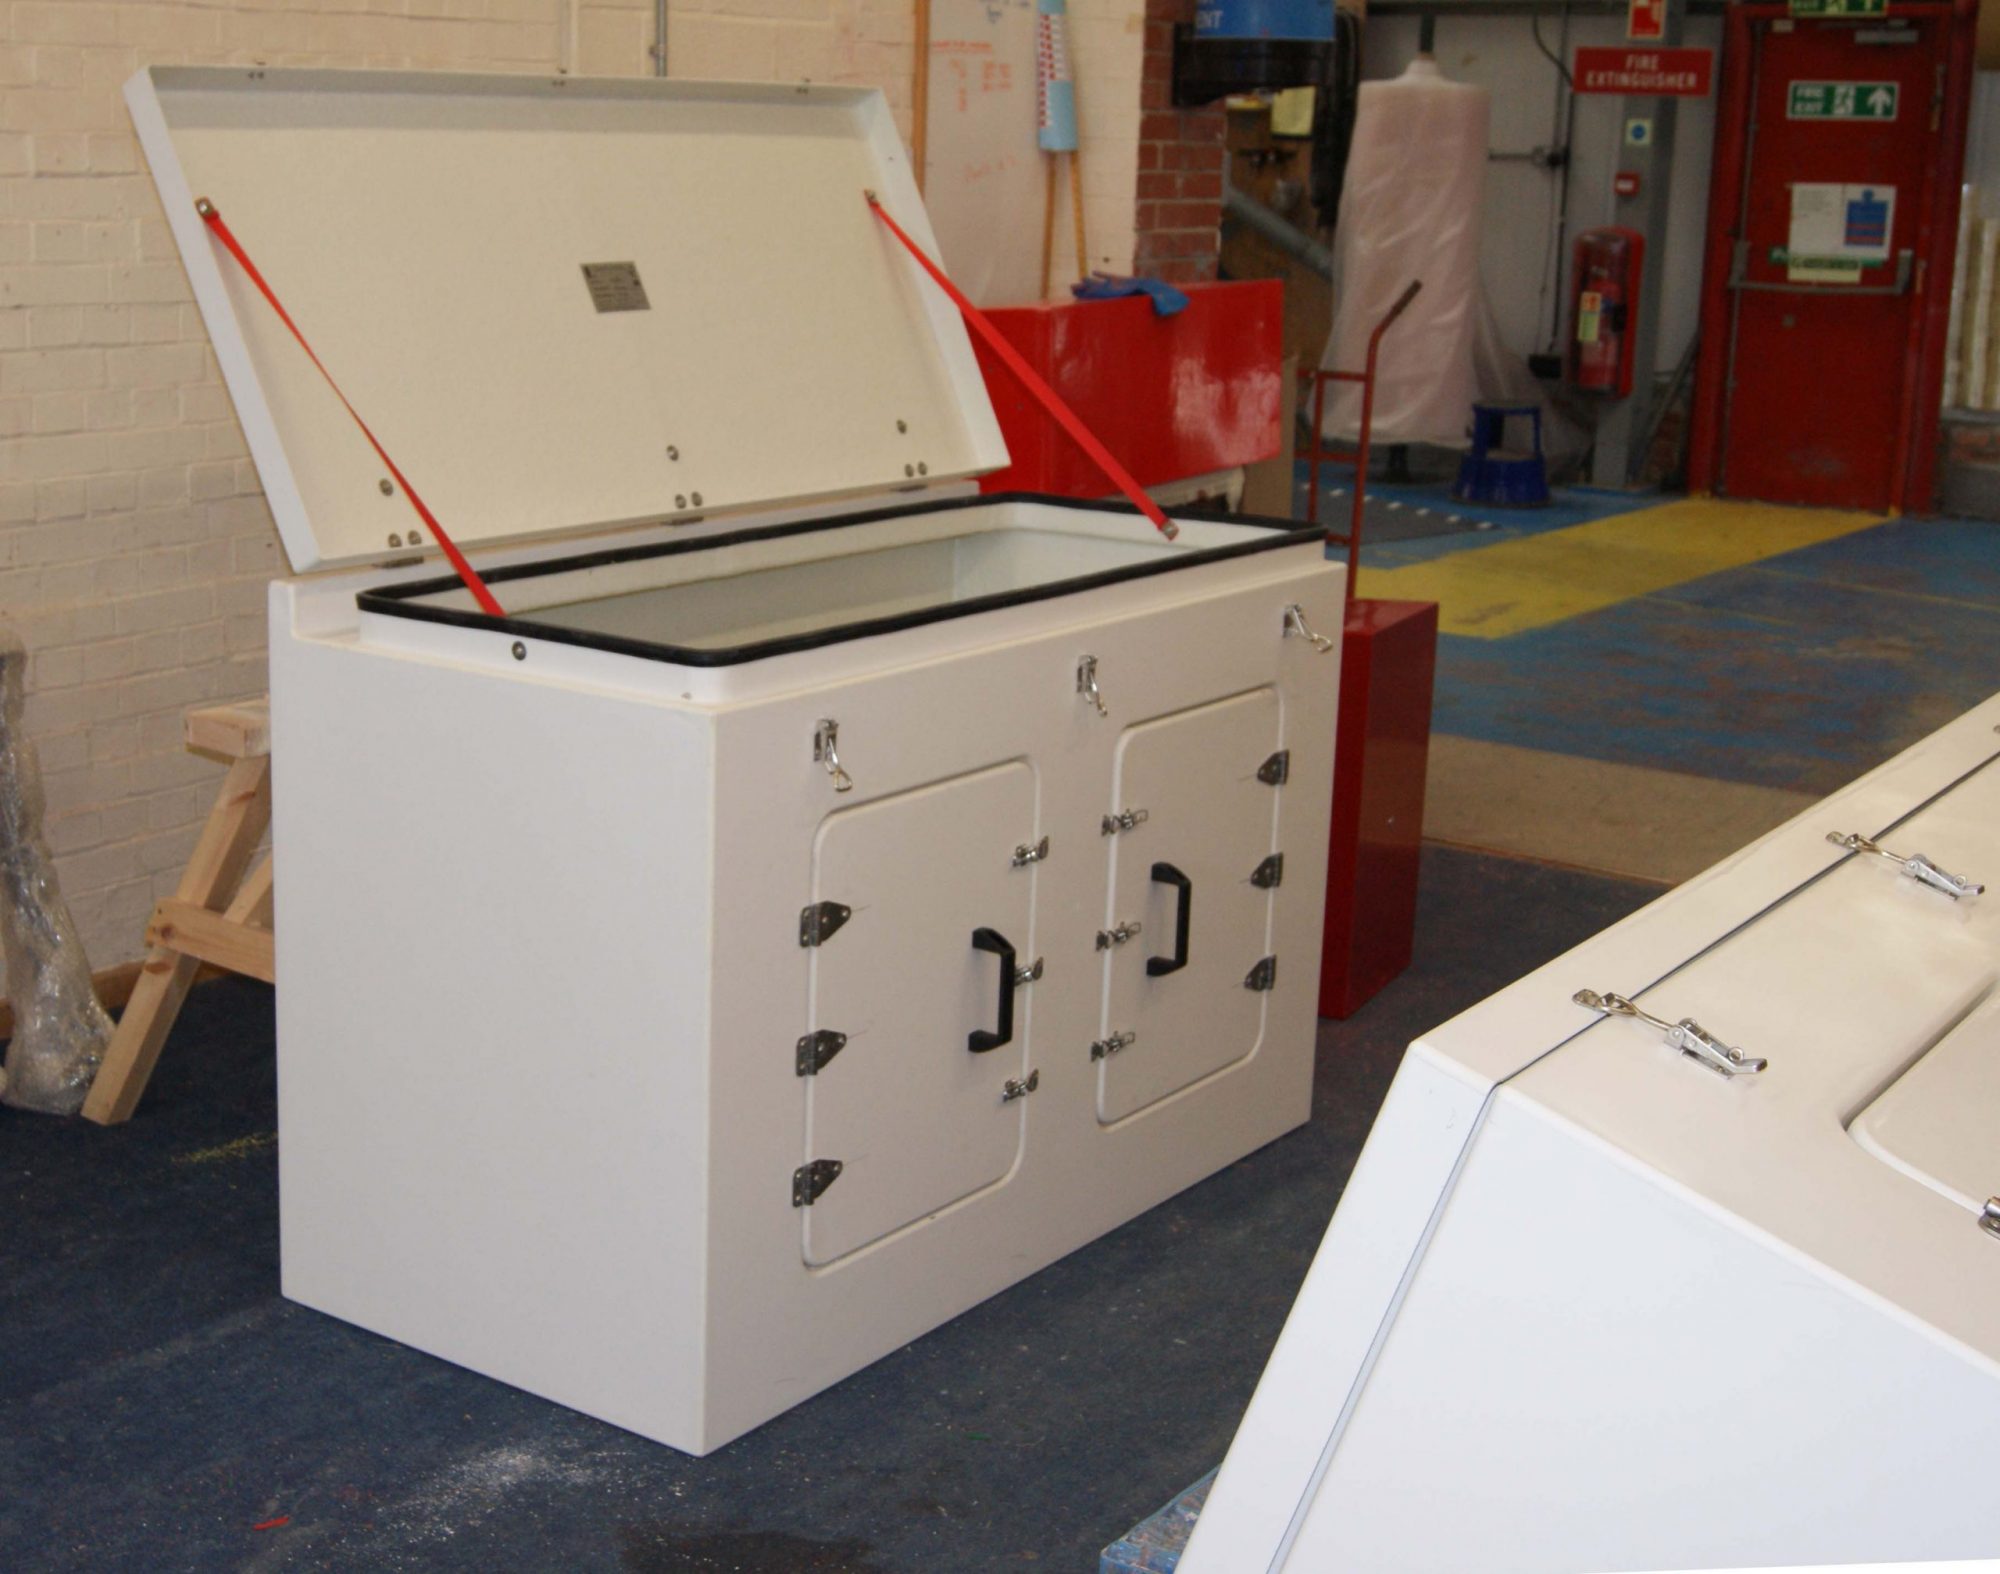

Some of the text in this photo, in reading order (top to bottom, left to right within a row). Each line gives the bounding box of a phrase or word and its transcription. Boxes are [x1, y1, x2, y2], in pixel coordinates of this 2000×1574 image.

[1625, 54, 1659, 70] FIRE
[1585, 71, 1697, 88] EXTINGUISHER
[1796, 86, 1824, 98] FIRE
[1794, 101, 1823, 113] EXIT
